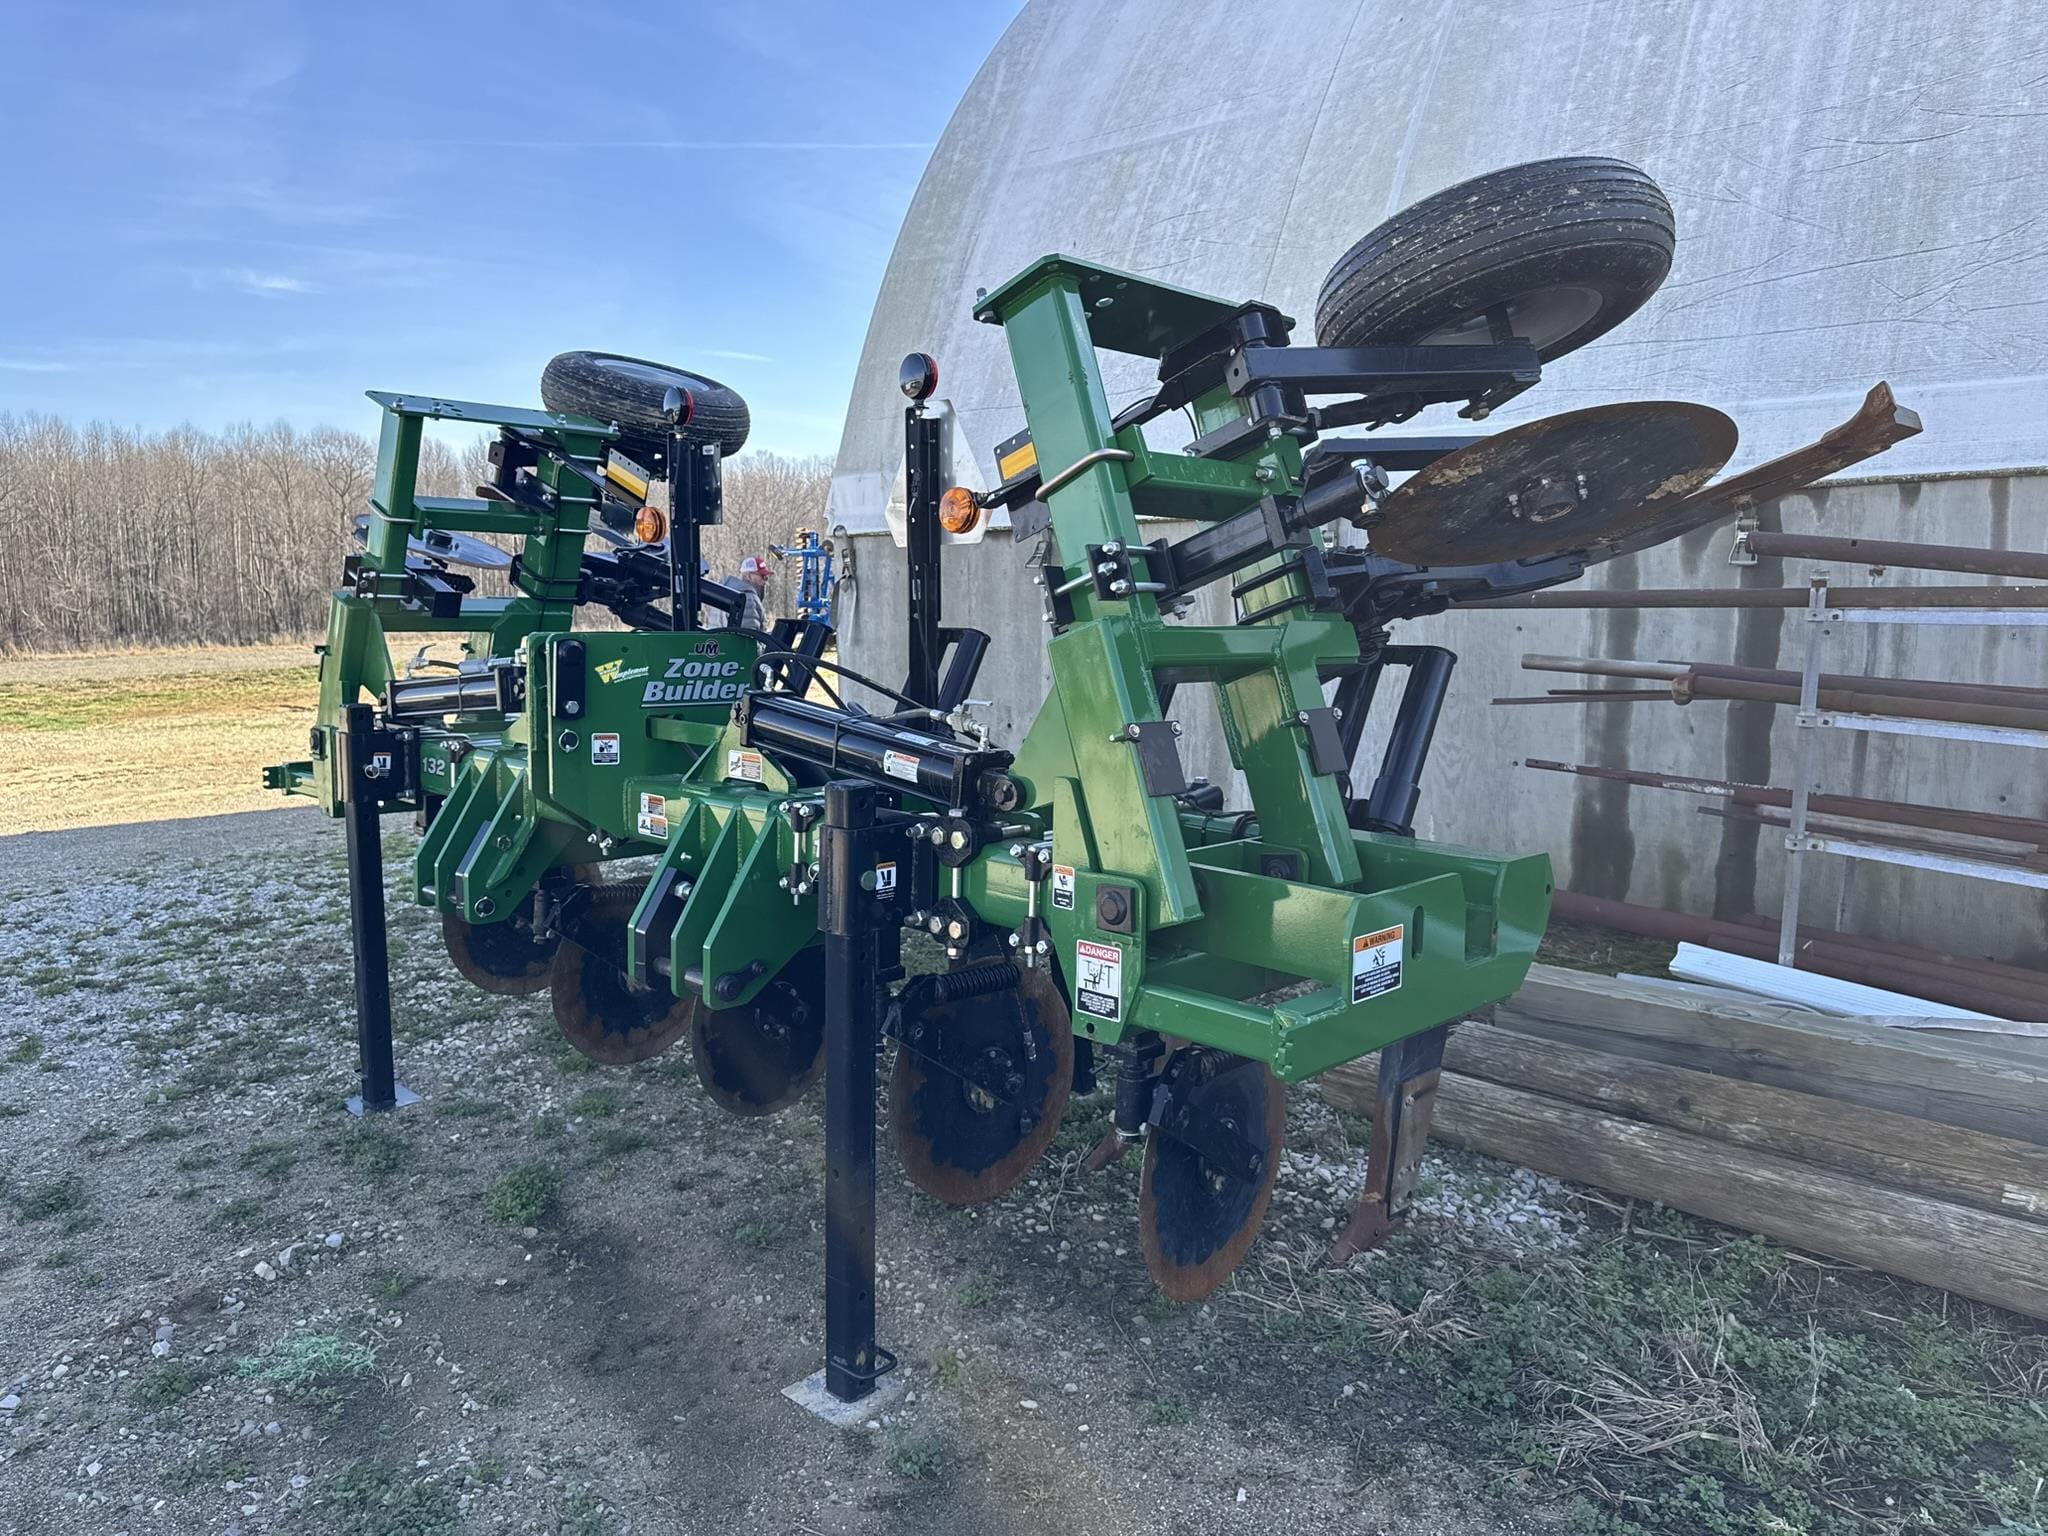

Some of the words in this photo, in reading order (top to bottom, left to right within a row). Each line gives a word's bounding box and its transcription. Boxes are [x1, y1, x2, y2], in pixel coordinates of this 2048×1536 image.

[694, 642, 719, 655] UM
[642, 680, 749, 702] Builder
[422, 757, 446, 776] 132
[1369, 930, 1396, 946] WARNING
[1085, 945, 1119, 961] DANGER
